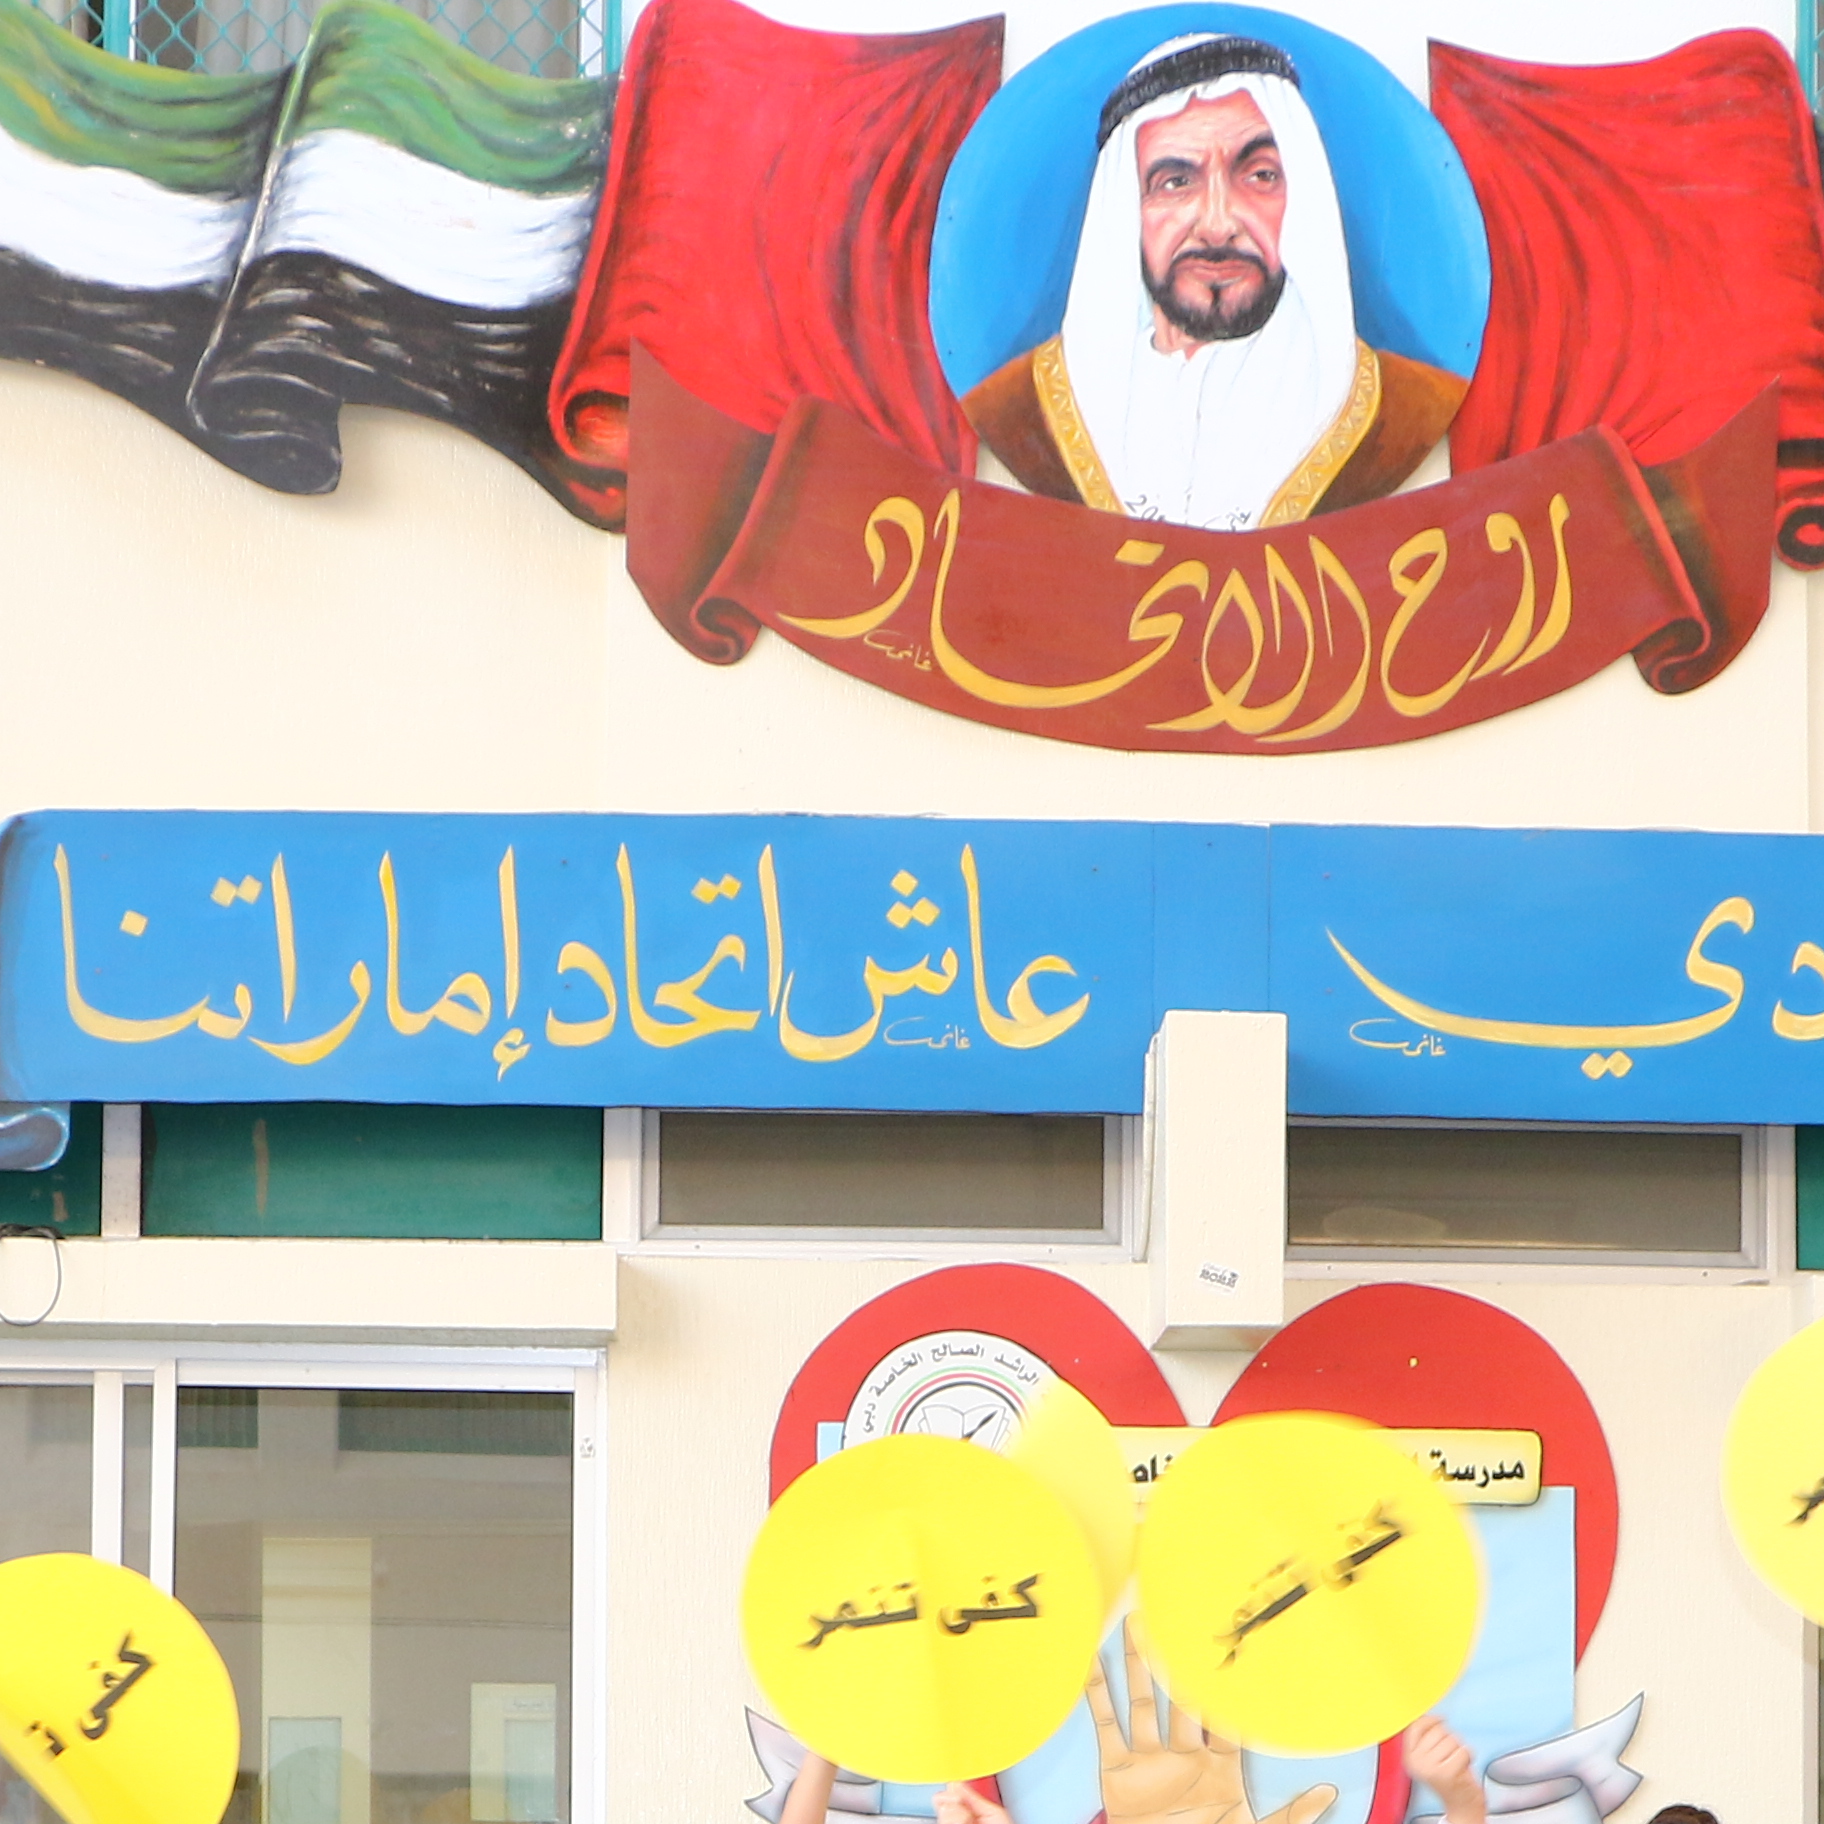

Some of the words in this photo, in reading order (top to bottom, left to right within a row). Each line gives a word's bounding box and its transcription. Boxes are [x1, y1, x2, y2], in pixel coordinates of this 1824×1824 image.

[776, 488, 1372, 744] الاتحاد
[1381, 493, 1572, 718] روح
[54, 847, 529, 1083] إماراتنا
[547, 845, 782, 1048] اتحاد
[779, 845, 1090, 1062] عاش
[868, 1352, 924, 1398] الخاصة
[931, 1342, 985, 1362] الصالح
[993, 1350, 1040, 1386] الراشد
[1429, 1448, 1525, 1489] مدرسة
[79, 1630, 155, 1741] كفى
